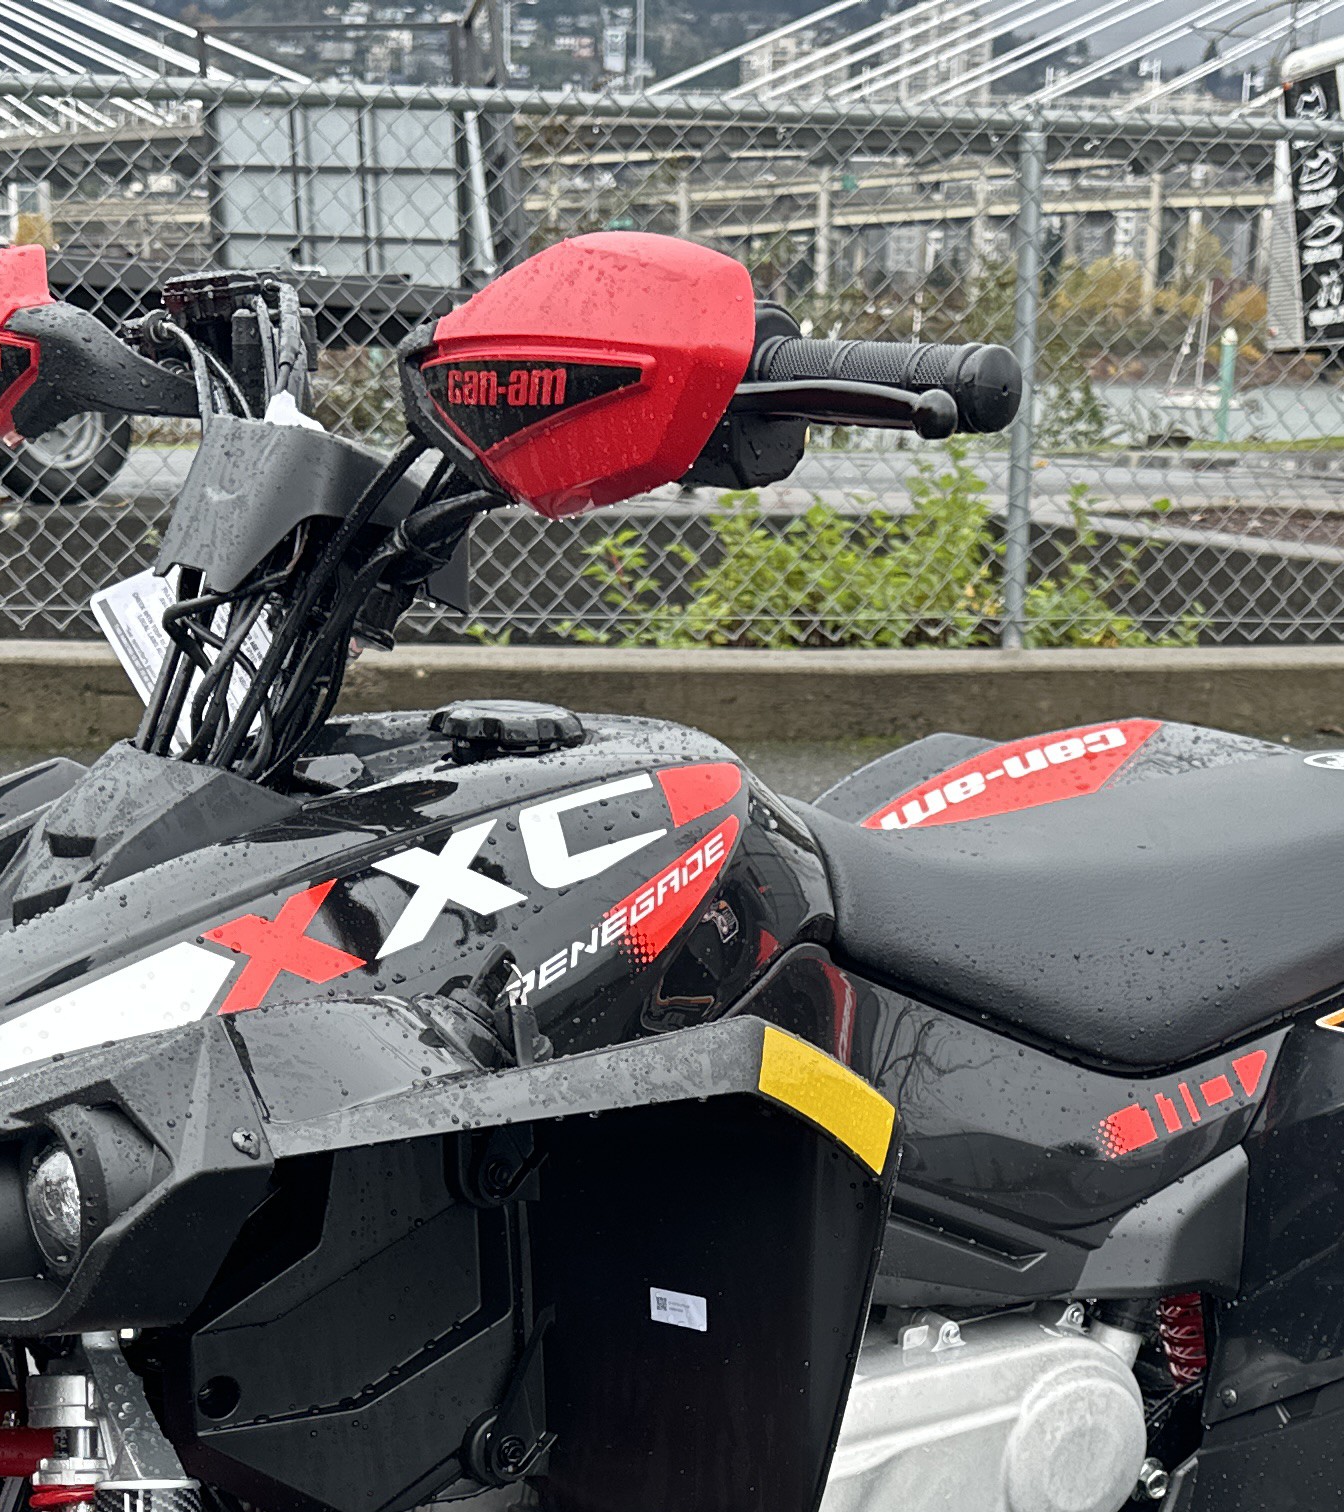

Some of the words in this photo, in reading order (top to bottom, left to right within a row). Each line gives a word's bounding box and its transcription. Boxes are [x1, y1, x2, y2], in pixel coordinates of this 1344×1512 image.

[447, 367, 568, 407] can-am
[880, 728, 1127, 830] can-am
[506, 832, 724, 1003] RENEGADE
